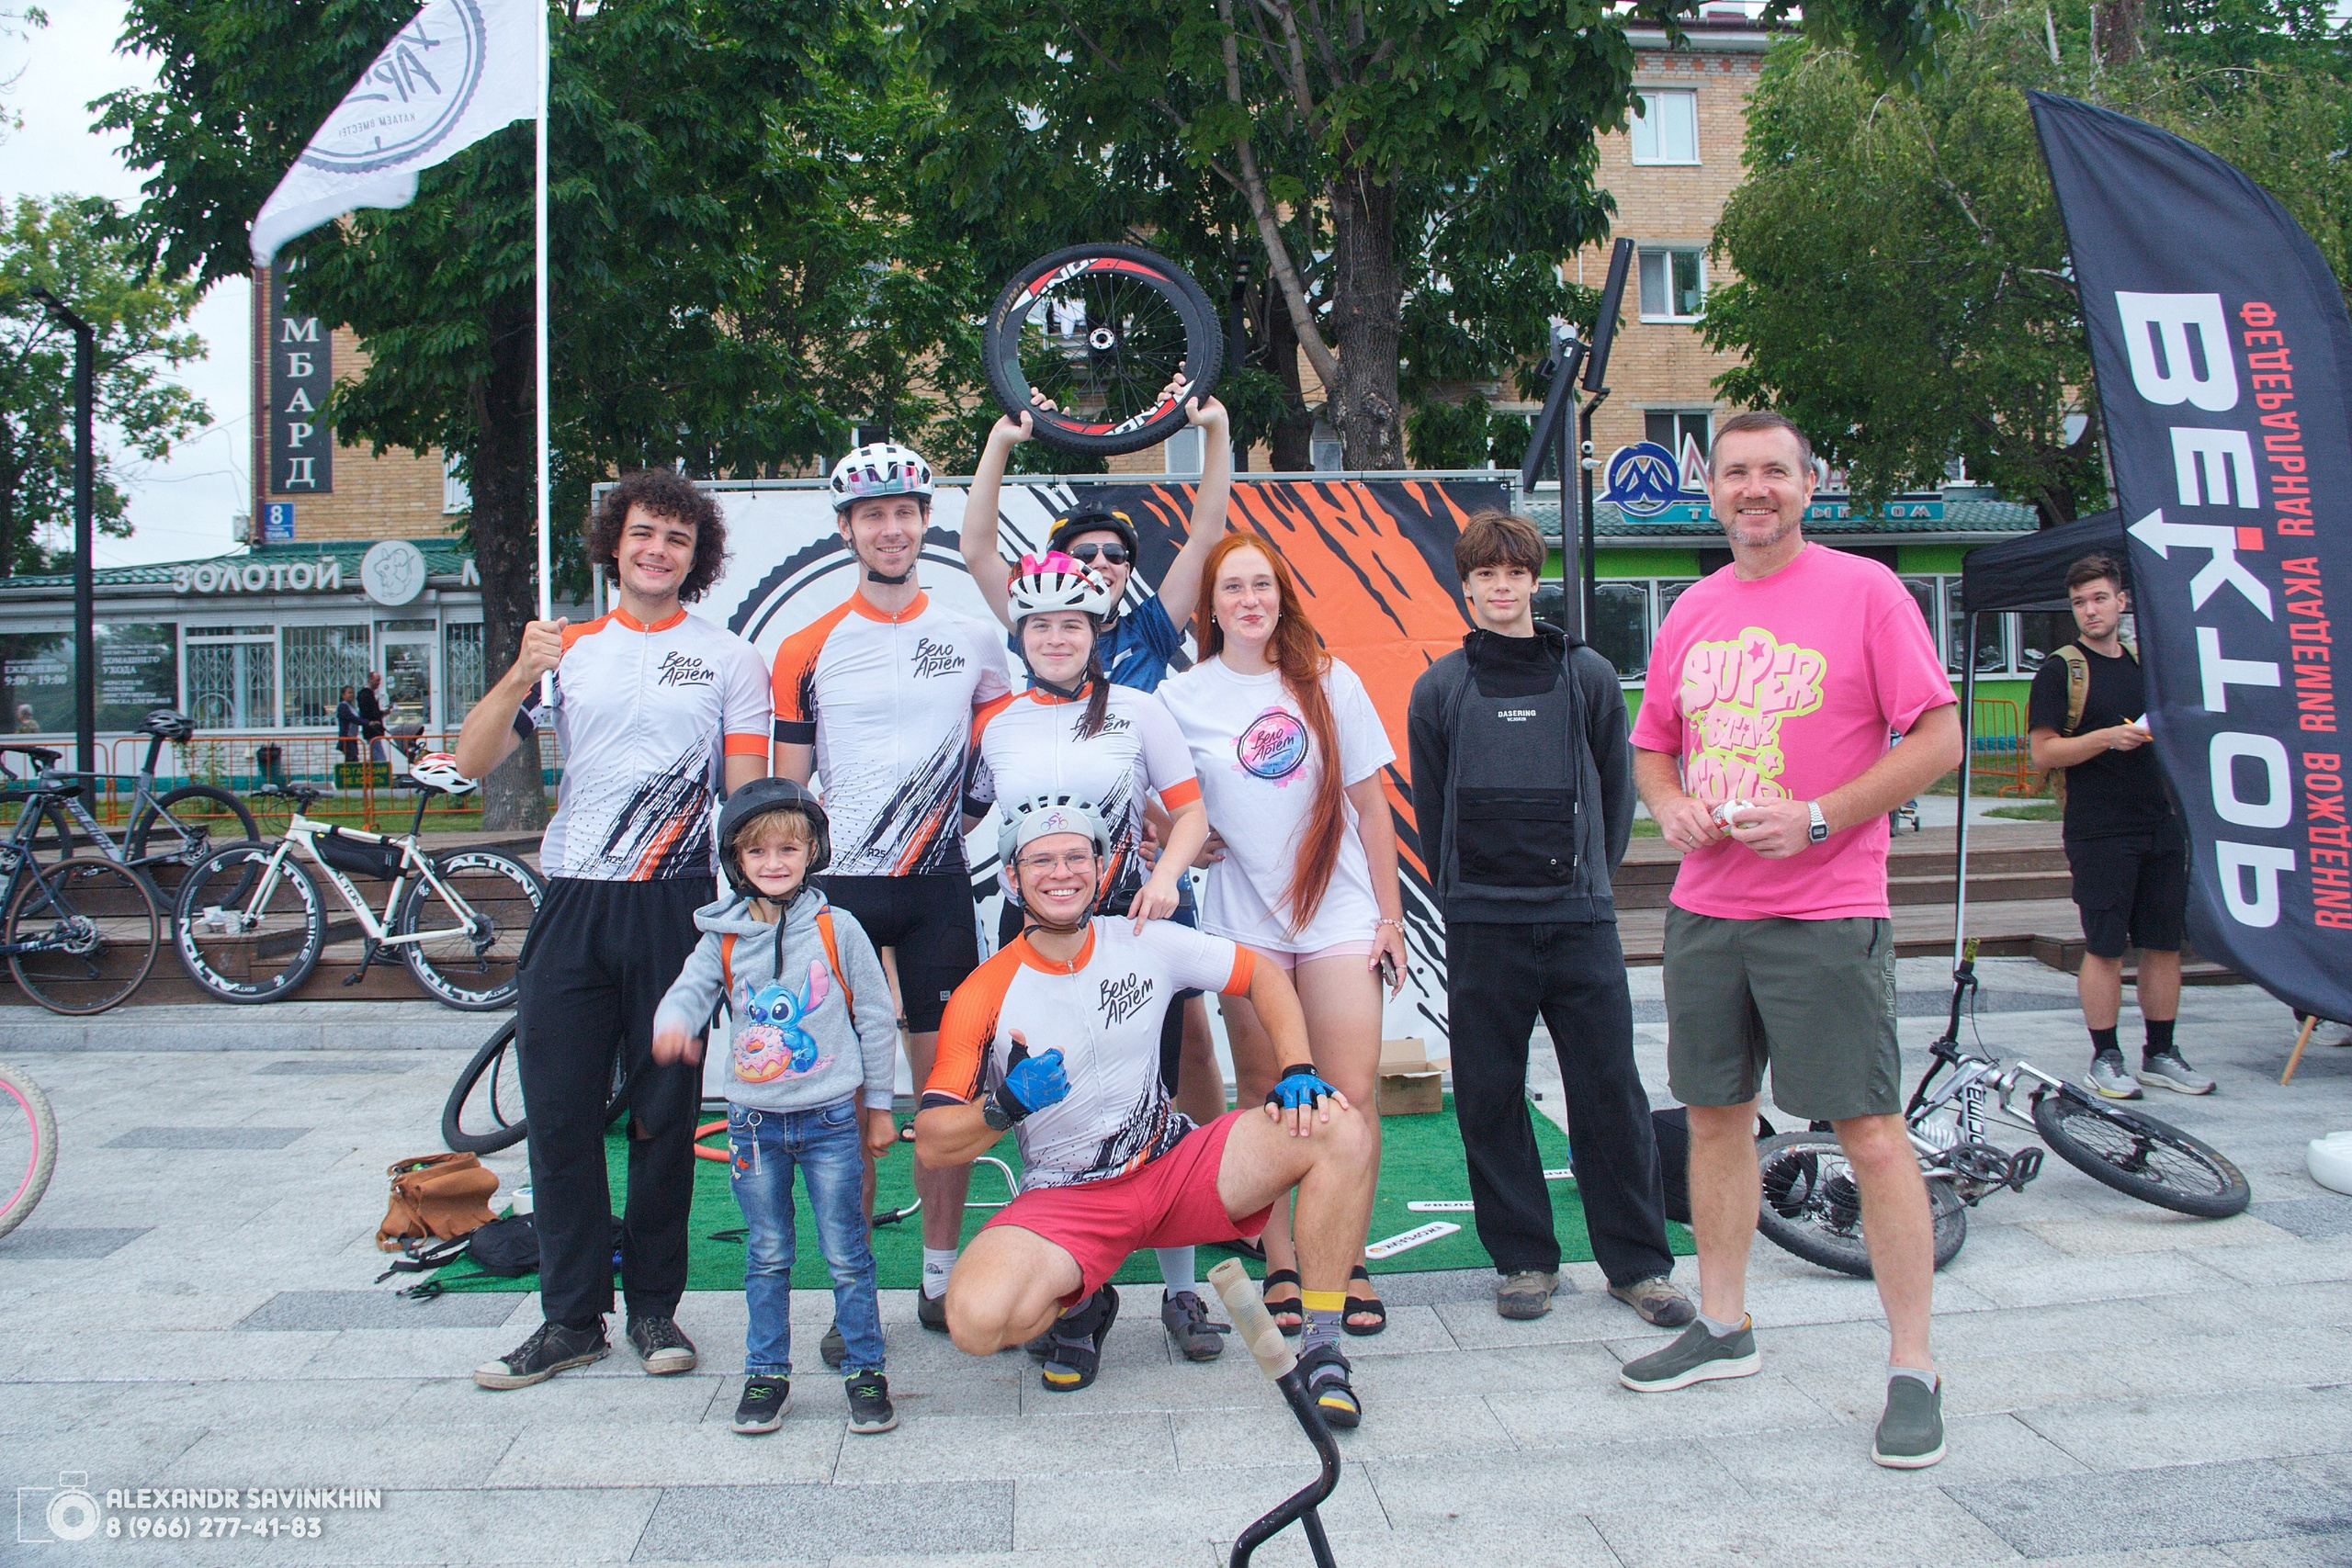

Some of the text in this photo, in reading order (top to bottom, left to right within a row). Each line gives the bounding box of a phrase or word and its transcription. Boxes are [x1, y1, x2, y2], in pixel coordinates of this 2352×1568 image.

[281, 254, 320, 489] МБАРД
[270, 505, 283, 525] 8
[172, 555, 344, 592] ЗОЛОТОЙ
[657, 651, 703, 671] Вело
[910, 637, 954, 662] Вело
[913, 656, 966, 679] Артём
[658, 666, 715, 687] Артём
[1680, 632, 1823, 716] SUPER
[1498, 709, 1537, 718] DASERING
[1704, 706, 1777, 750] STAR
[1250, 728, 1284, 750] Вело
[179, 918, 241, 992] ALTON
[411, 949, 492, 1003] ALTON
[1097, 972, 1137, 1011] Вело
[1104, 978, 1154, 1030] Артём
